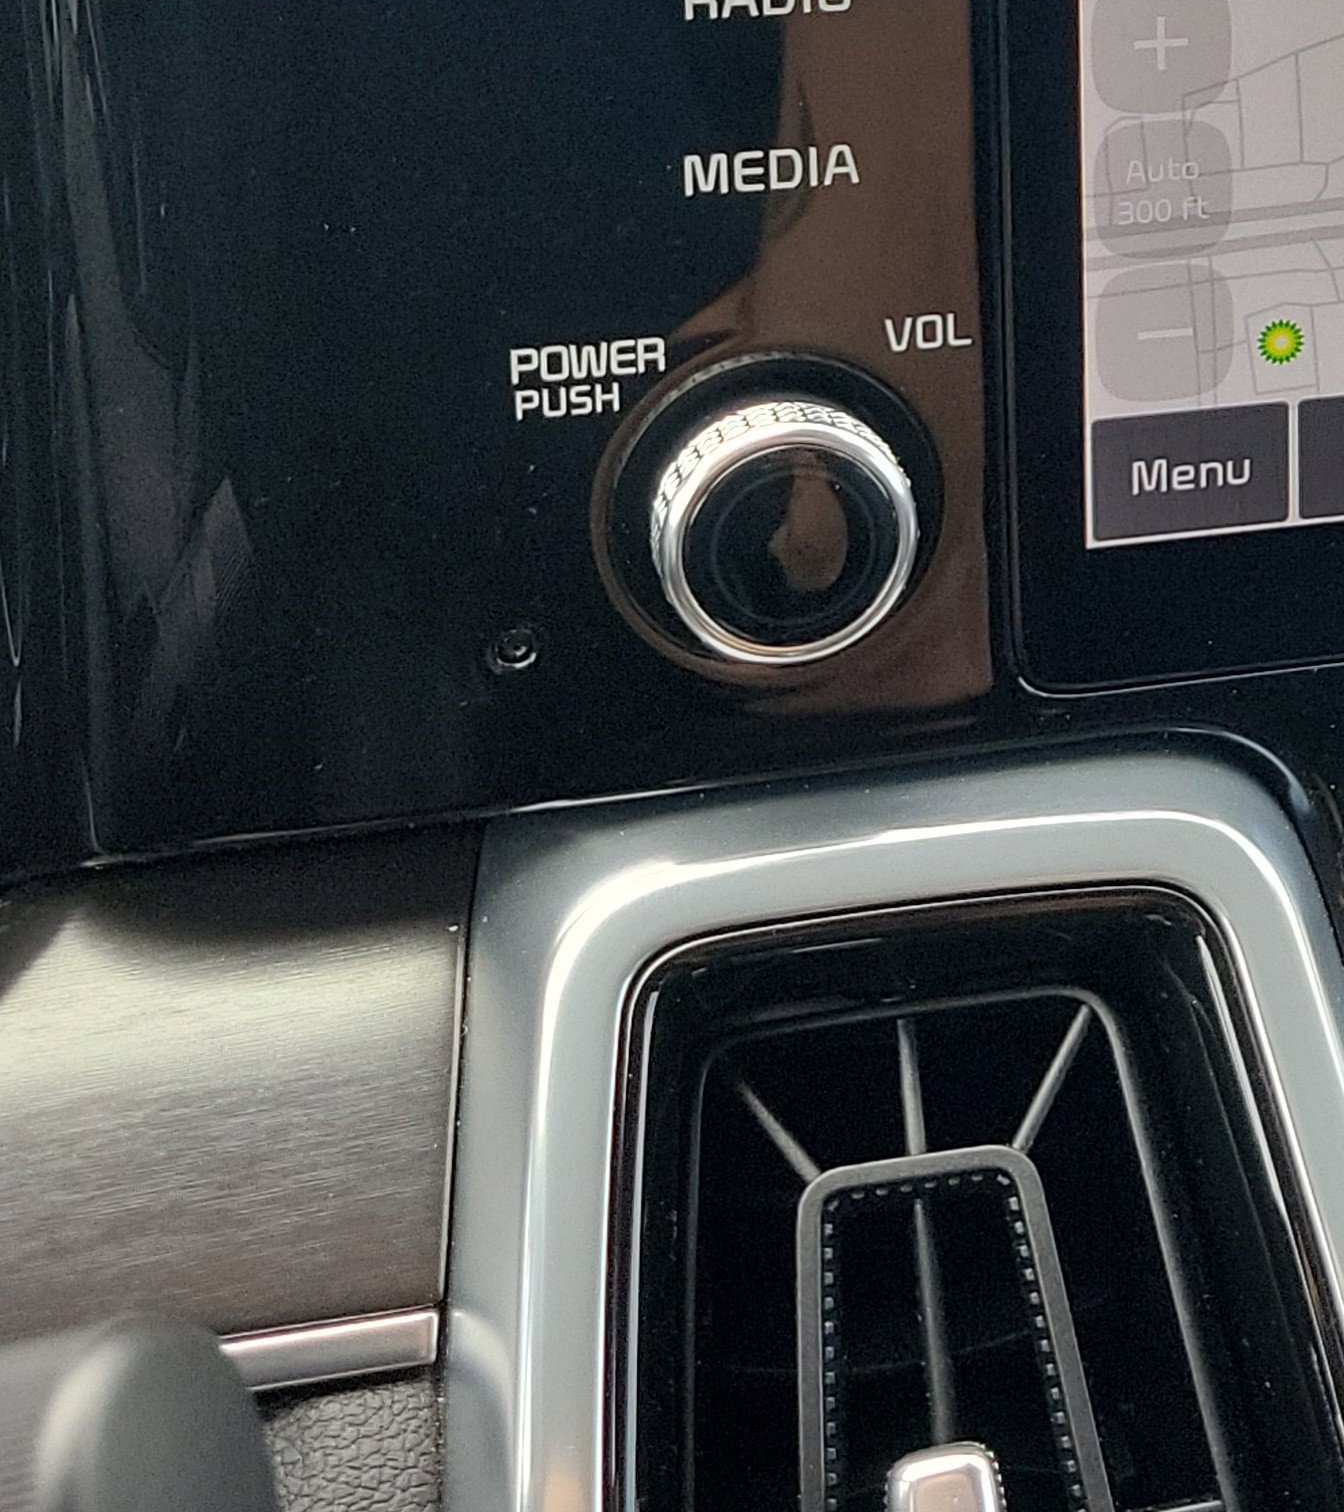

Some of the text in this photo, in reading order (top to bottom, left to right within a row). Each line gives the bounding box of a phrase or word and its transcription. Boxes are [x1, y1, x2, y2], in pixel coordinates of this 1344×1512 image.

[683, 144, 860, 197] MEDIA
[1125, 156, 1202, 184] Auto
[1114, 193, 1212, 224] 300 ft
[884, 313, 973, 352] VOL
[509, 336, 667, 385] POWER
[513, 382, 621, 422] PUSH
[1132, 458, 1251, 496] Menu
